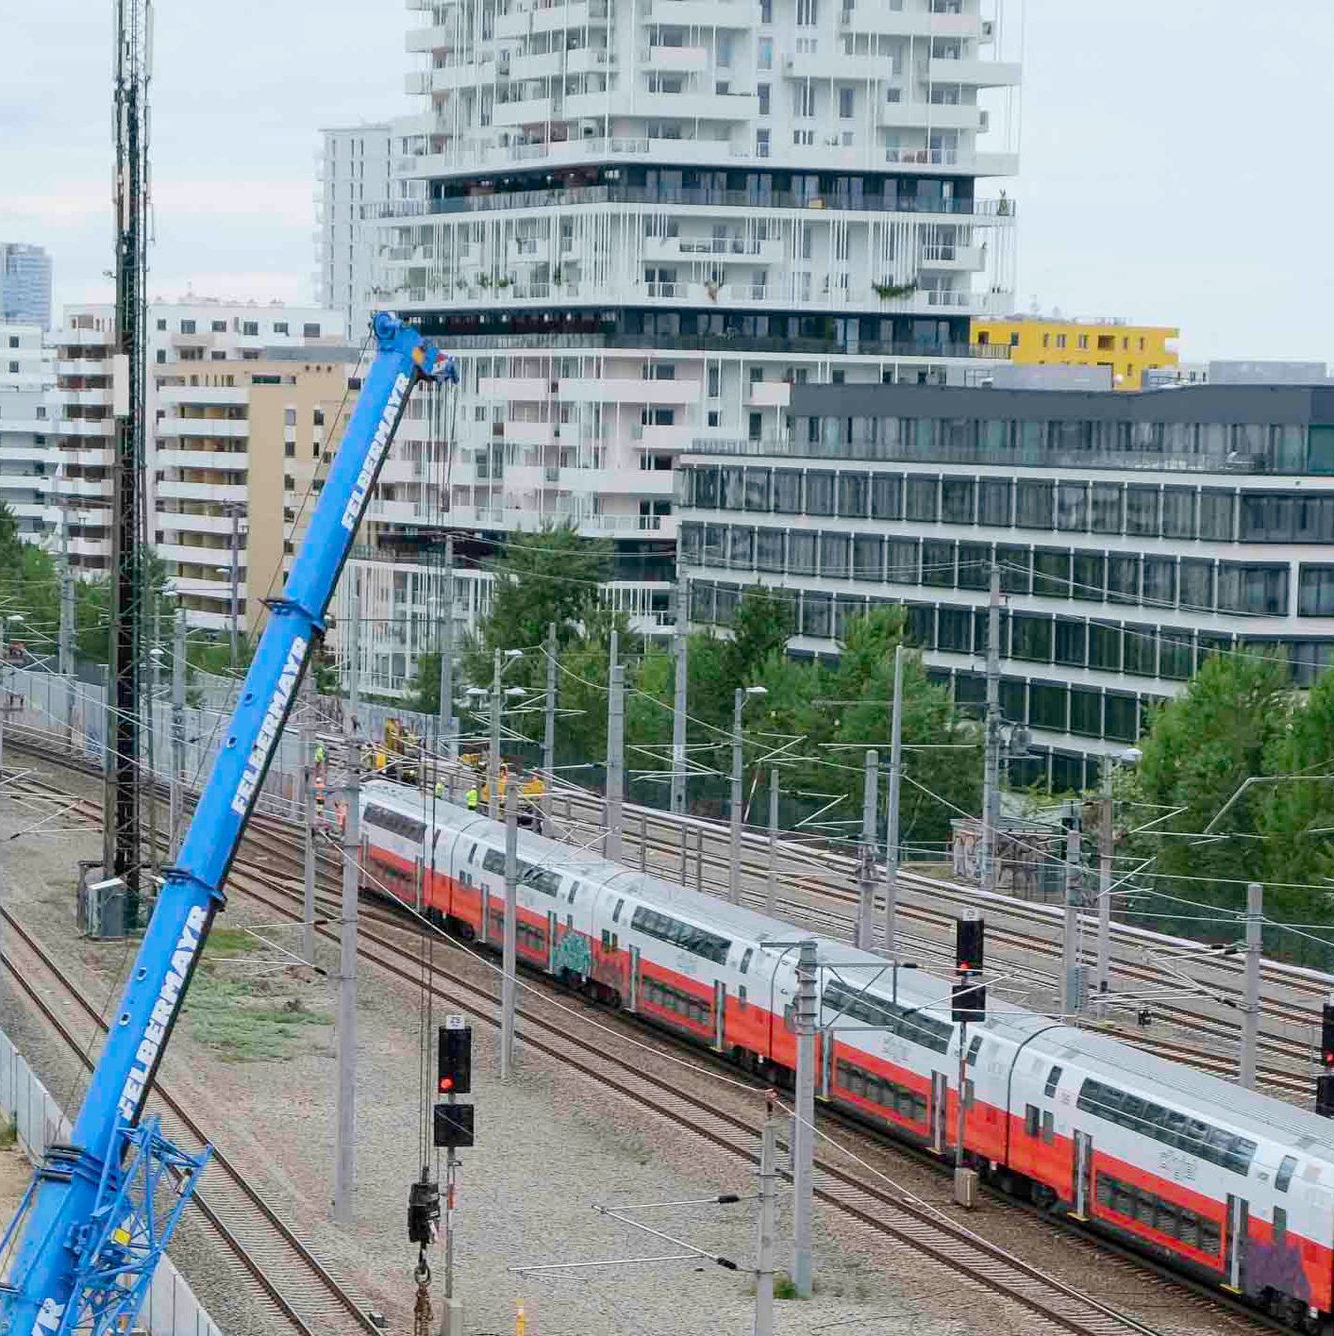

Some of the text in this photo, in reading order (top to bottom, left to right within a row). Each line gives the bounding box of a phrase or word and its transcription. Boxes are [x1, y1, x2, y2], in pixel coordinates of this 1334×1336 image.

[342, 372, 410, 531] FELBERMAYR
[231, 636, 308, 816] FELBERMAYR
[117, 904, 208, 1122] FELBERMAYR
